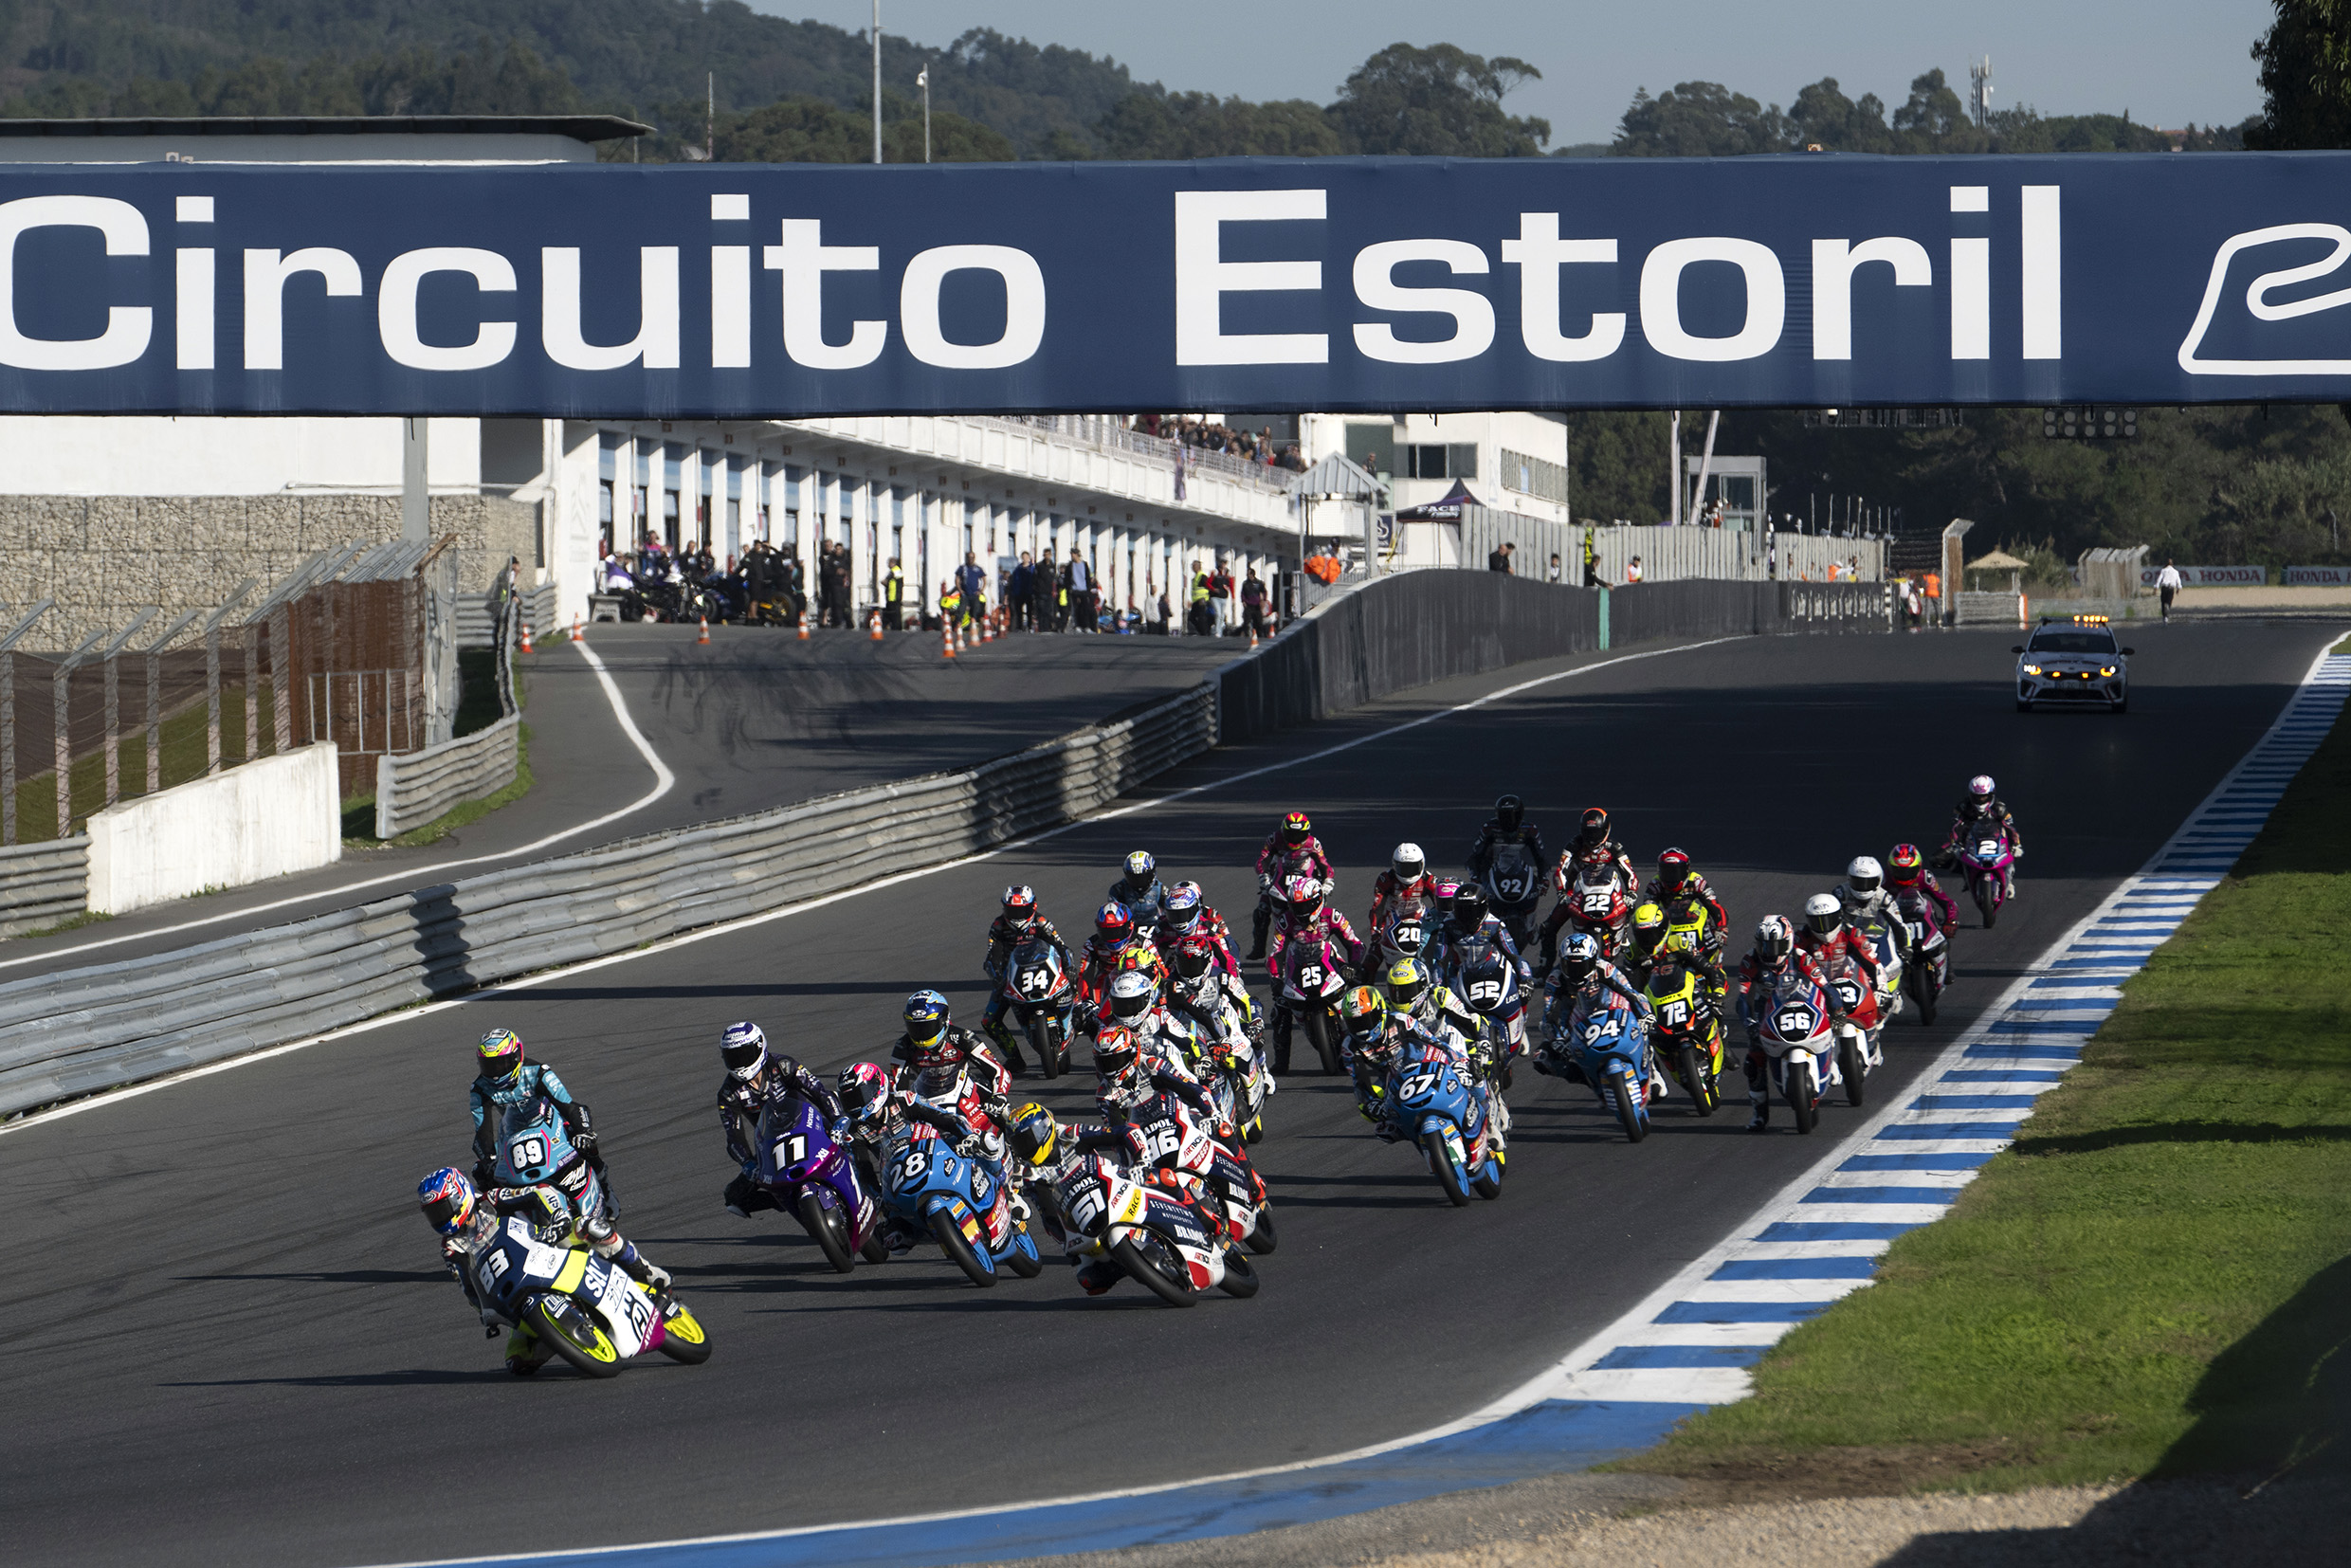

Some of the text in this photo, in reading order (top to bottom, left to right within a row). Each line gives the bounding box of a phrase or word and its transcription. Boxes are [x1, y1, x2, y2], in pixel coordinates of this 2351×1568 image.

[0, 185, 2062, 372] Circuito Estoril
[2199, 570, 2262, 583] HONDA
[2289, 570, 2342, 583] HONDA
[1978, 840, 1997, 855] 2
[1500, 879, 1522, 893] 92
[1583, 894, 1611, 912] 22
[1021, 969, 1048, 993] 34
[1301, 965, 1322, 989] 25
[1469, 980, 1501, 1001] 52
[1662, 1000, 1687, 1027] 72
[1779, 1012, 1811, 1032] 56
[1584, 1019, 1620, 1047] 94
[1398, 1073, 1436, 1101] 67
[1144, 1118, 1175, 1137] ADOL
[512, 1139, 543, 1170] 89
[772, 1136, 806, 1172] 11
[890, 1152, 926, 1193] 28
[1110, 1181, 1130, 1210] ARTBOX
[1127, 1192, 1141, 1217] RACC
[1070, 1187, 1107, 1233] 51
[479, 1248, 510, 1295] 83
